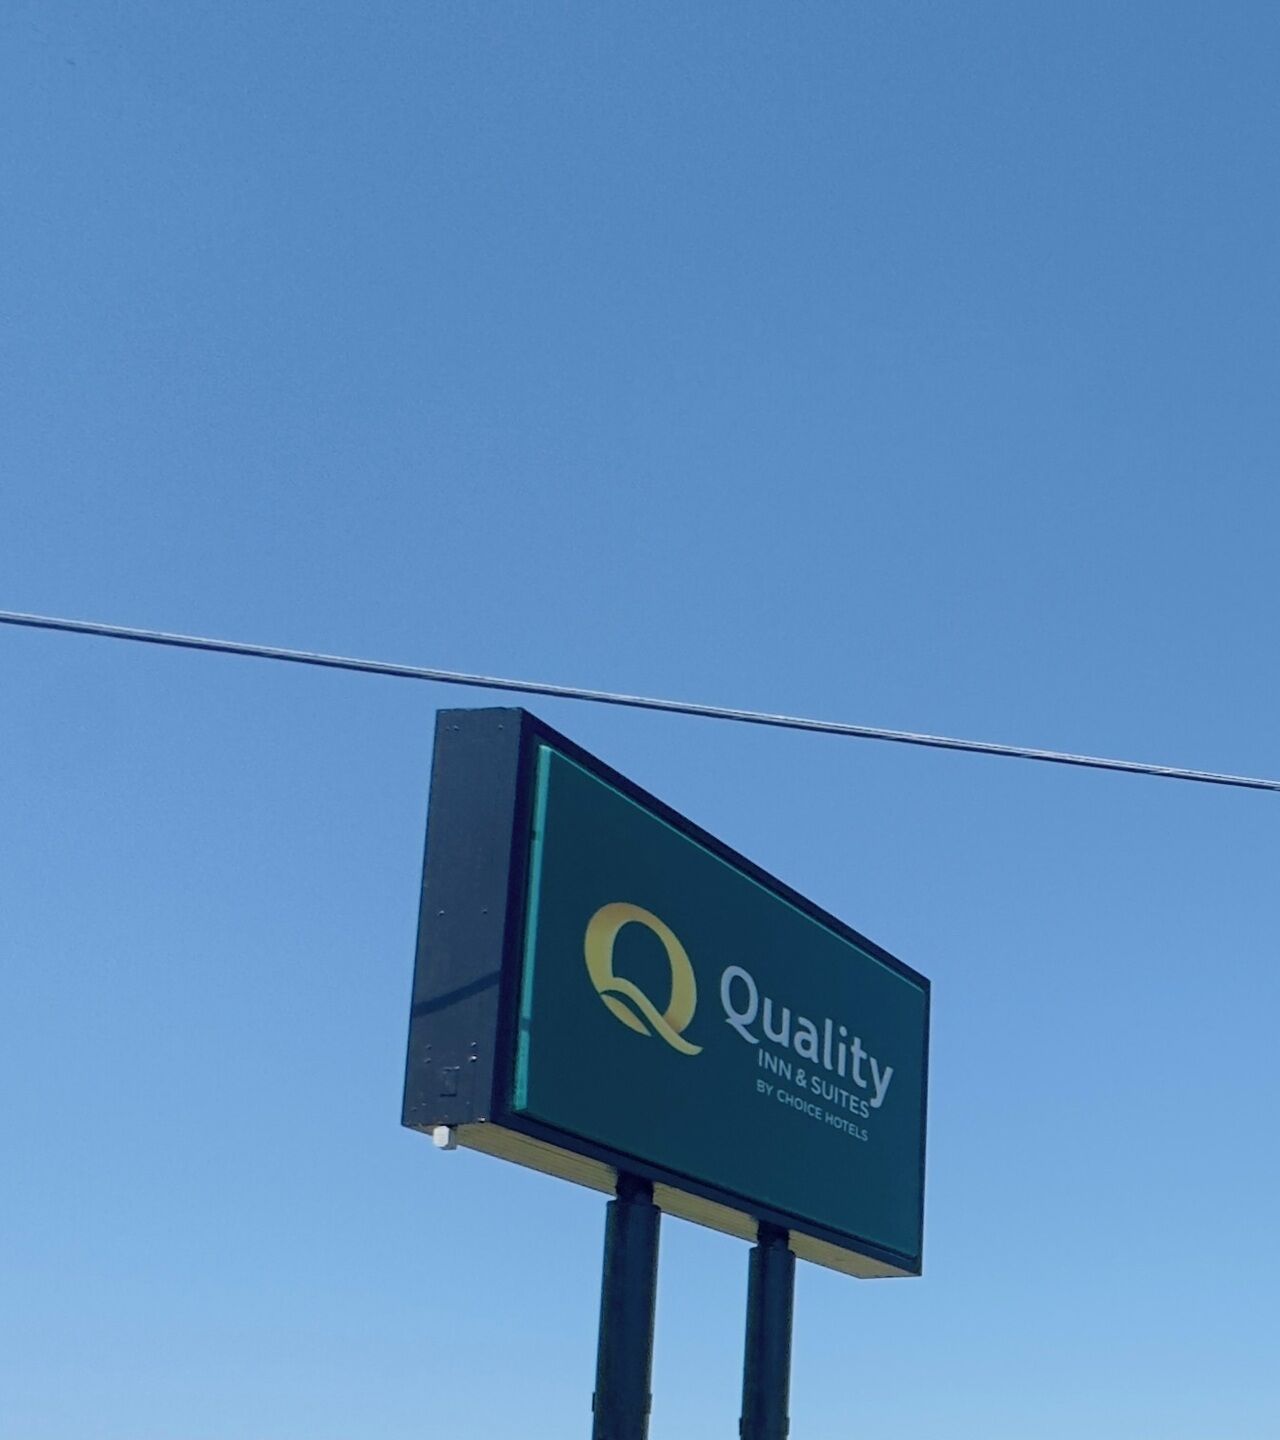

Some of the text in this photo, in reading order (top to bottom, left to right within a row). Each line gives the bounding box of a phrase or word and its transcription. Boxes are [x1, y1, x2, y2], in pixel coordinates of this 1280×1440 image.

[583, 902, 703, 1056] Q
[720, 965, 894, 1109] Quality
[758, 1048, 870, 1119] INN & SUITES
[756, 1079, 868, 1141] BY CHOICE HOTELS
